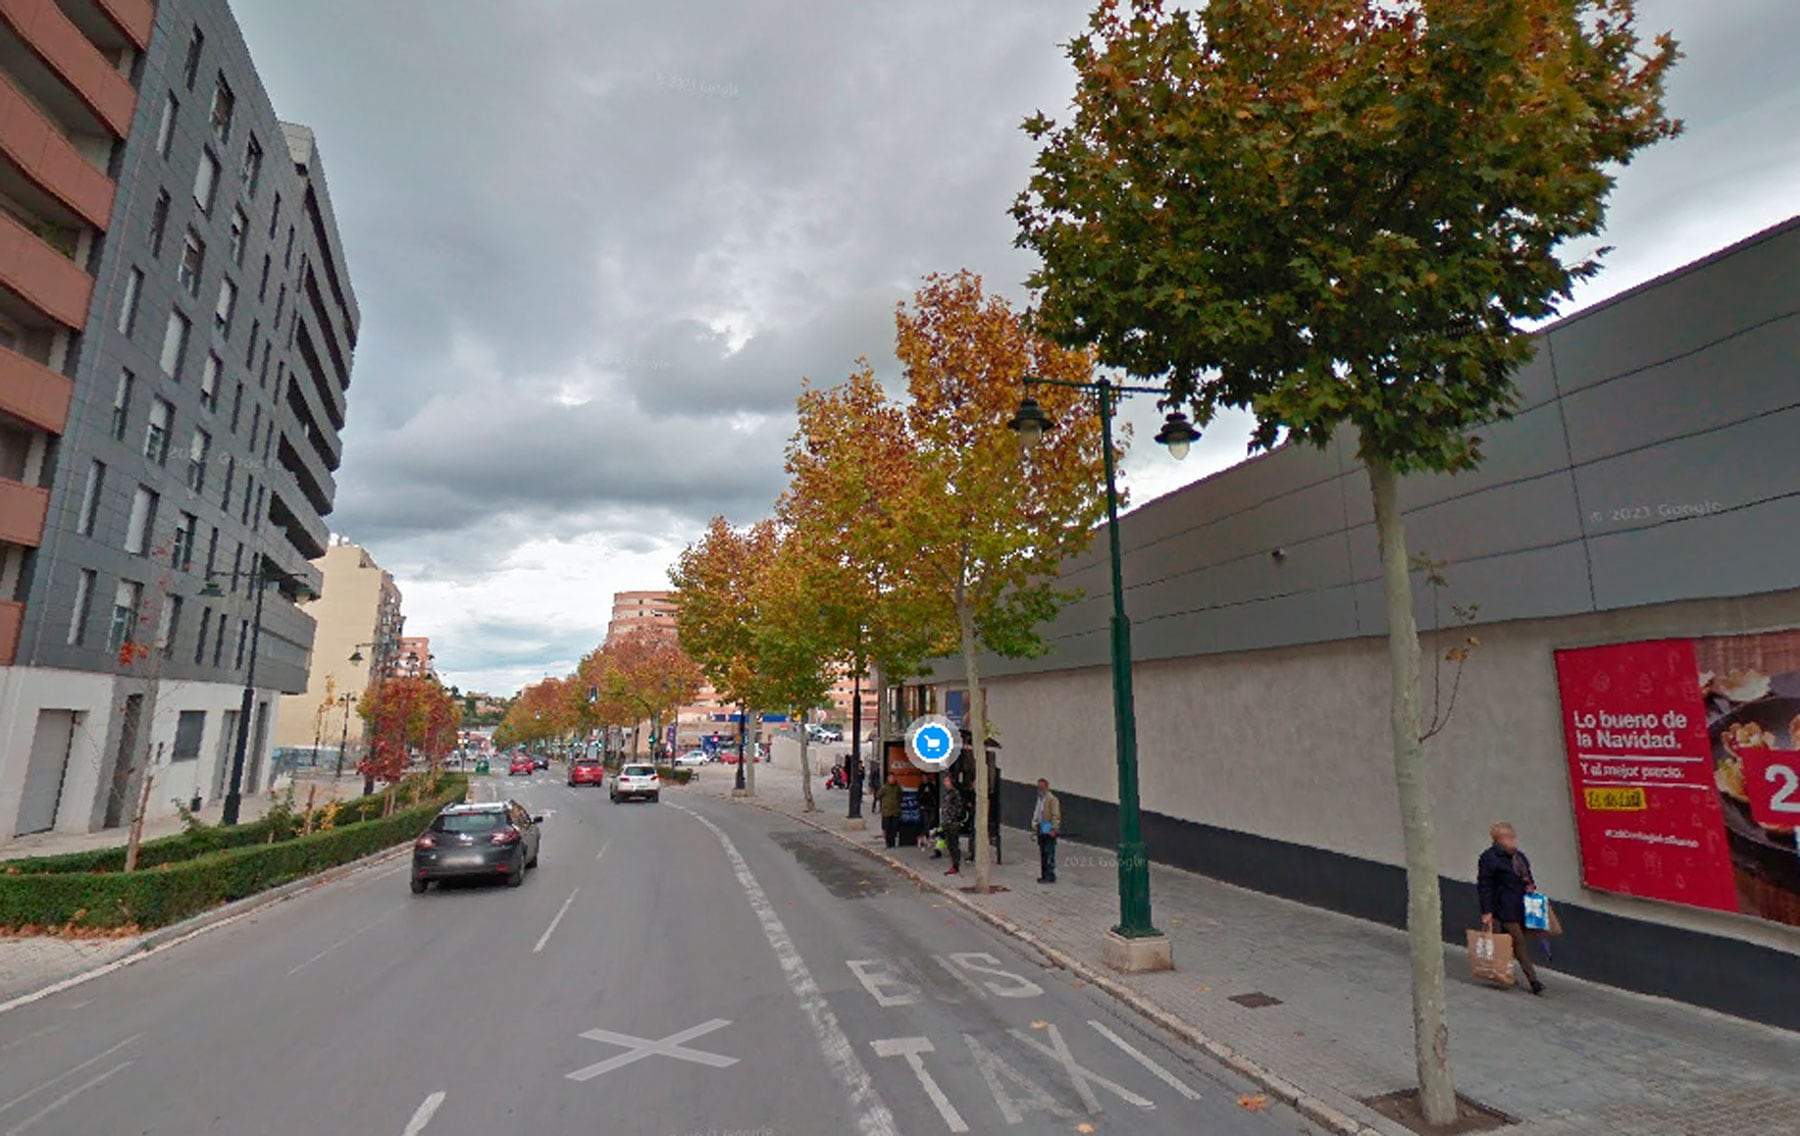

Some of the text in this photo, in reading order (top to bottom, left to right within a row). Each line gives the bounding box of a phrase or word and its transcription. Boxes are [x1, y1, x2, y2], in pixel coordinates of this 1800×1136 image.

[1573, 709, 1687, 729] Lo bueno de
[1575, 729, 1682, 749] la Navidad.
[1580, 762, 1588, 774] Y
[1603, 764, 1639, 778] mejor
[1641, 766, 1685, 780] precio.
[869, 1018, 1203, 1133] TAXI
